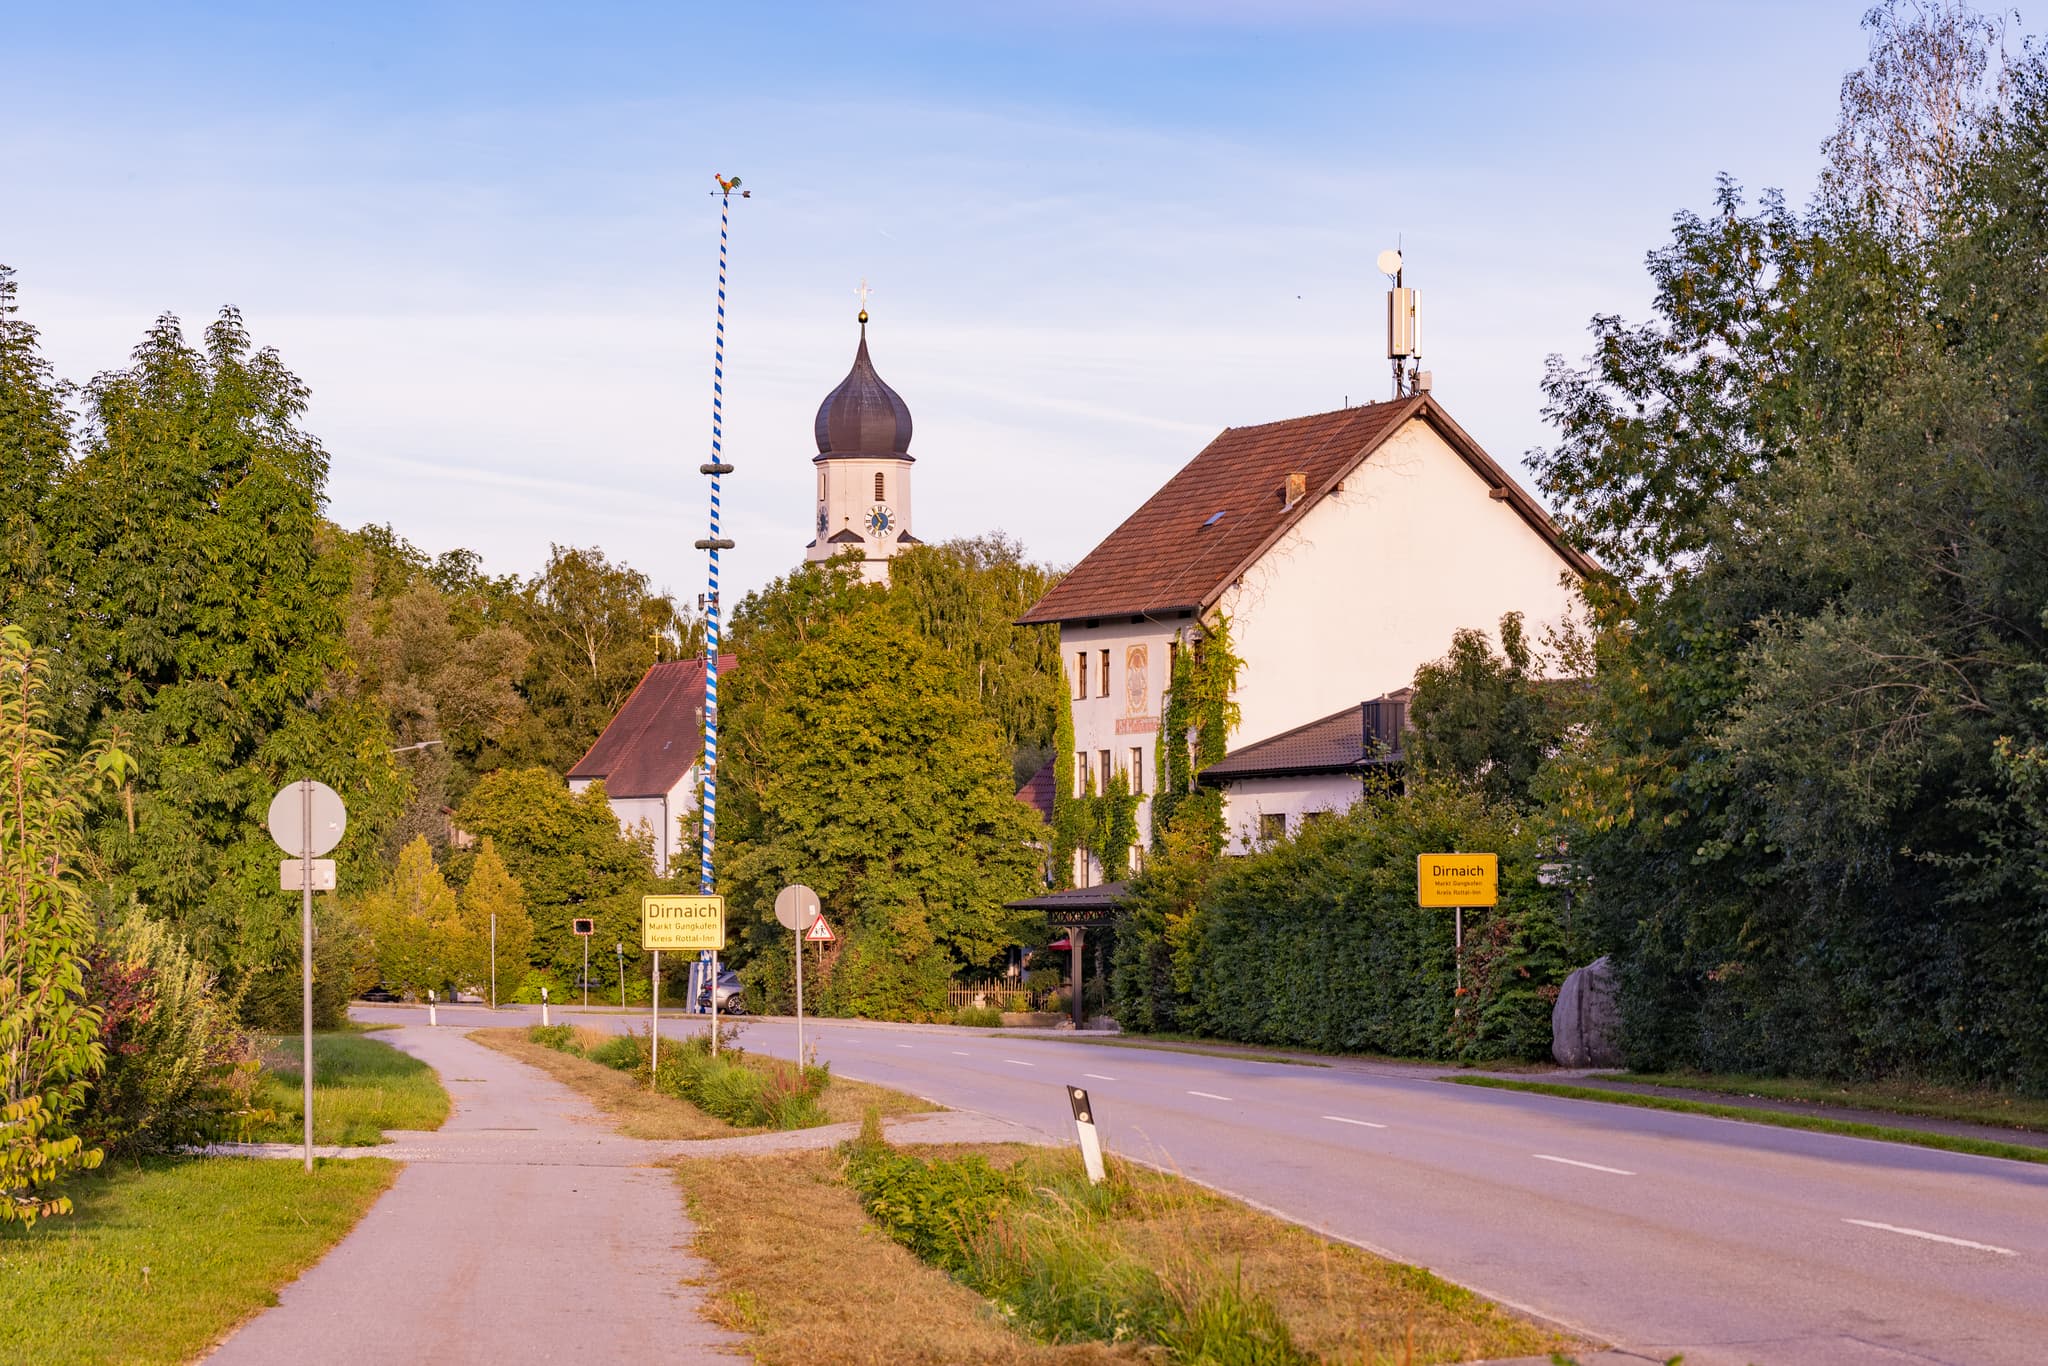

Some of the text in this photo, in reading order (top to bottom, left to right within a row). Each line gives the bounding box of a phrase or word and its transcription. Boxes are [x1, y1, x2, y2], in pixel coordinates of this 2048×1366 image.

[1433, 865, 1484, 877] Dirnaich
[649, 903, 718, 918] Dirnaich
[649, 922, 717, 932] Markt Gangkofen
[651, 935, 715, 943] Kreis Rottal-Inn
